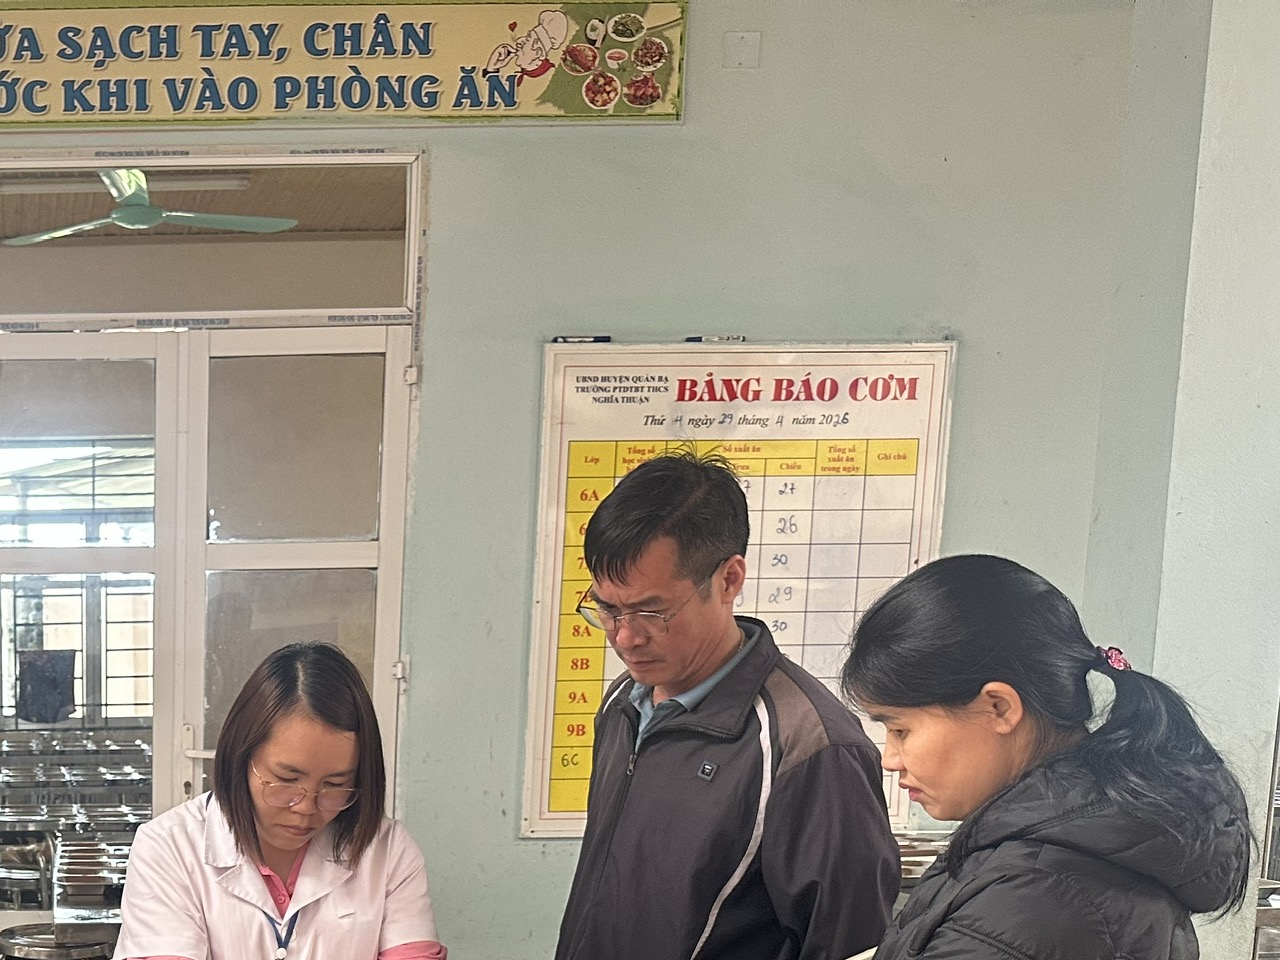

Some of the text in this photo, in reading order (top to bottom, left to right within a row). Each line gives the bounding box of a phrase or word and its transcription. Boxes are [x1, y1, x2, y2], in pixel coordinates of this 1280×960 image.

[56, 24, 180, 69] SẠCH
[193, 23, 288, 62] TAY,
[304, 14, 432, 58] CHÂN
[61, 78, 150, 113] KHI
[163, 67, 258, 112] VÀO
[273, 66, 440, 110] PHÒNG
[451, 66, 520, 109] ĂN
[575, 375, 600, 383] UBND
[575, 384, 611, 393] TRƯỜNG
[676, 372, 919, 403] BẢNG BÁO CƠM
[643, 414, 667, 426] Thứ
[688, 414, 715, 428] ngày
[718, 413, 733, 425] 29
[738, 414, 769, 427] tháng
[775, 415, 784, 426] 4
[792, 414, 816, 425] năm
[818, 412, 850, 427] 2026
[584, 455, 600, 465] Lớp
[579, 488, 600, 502] 6A
[778, 482, 796, 495] 27
[776, 515, 798, 535] 26
[771, 553, 788, 567] 30
[768, 586, 792, 604] 29
[571, 623, 592, 638] 8A
[771, 620, 788, 633] 30
[570, 656, 590, 671] 8B
[568, 690, 588, 705] 9A
[566, 723, 586, 737] 9B
[561, 753, 579, 768] 6C
